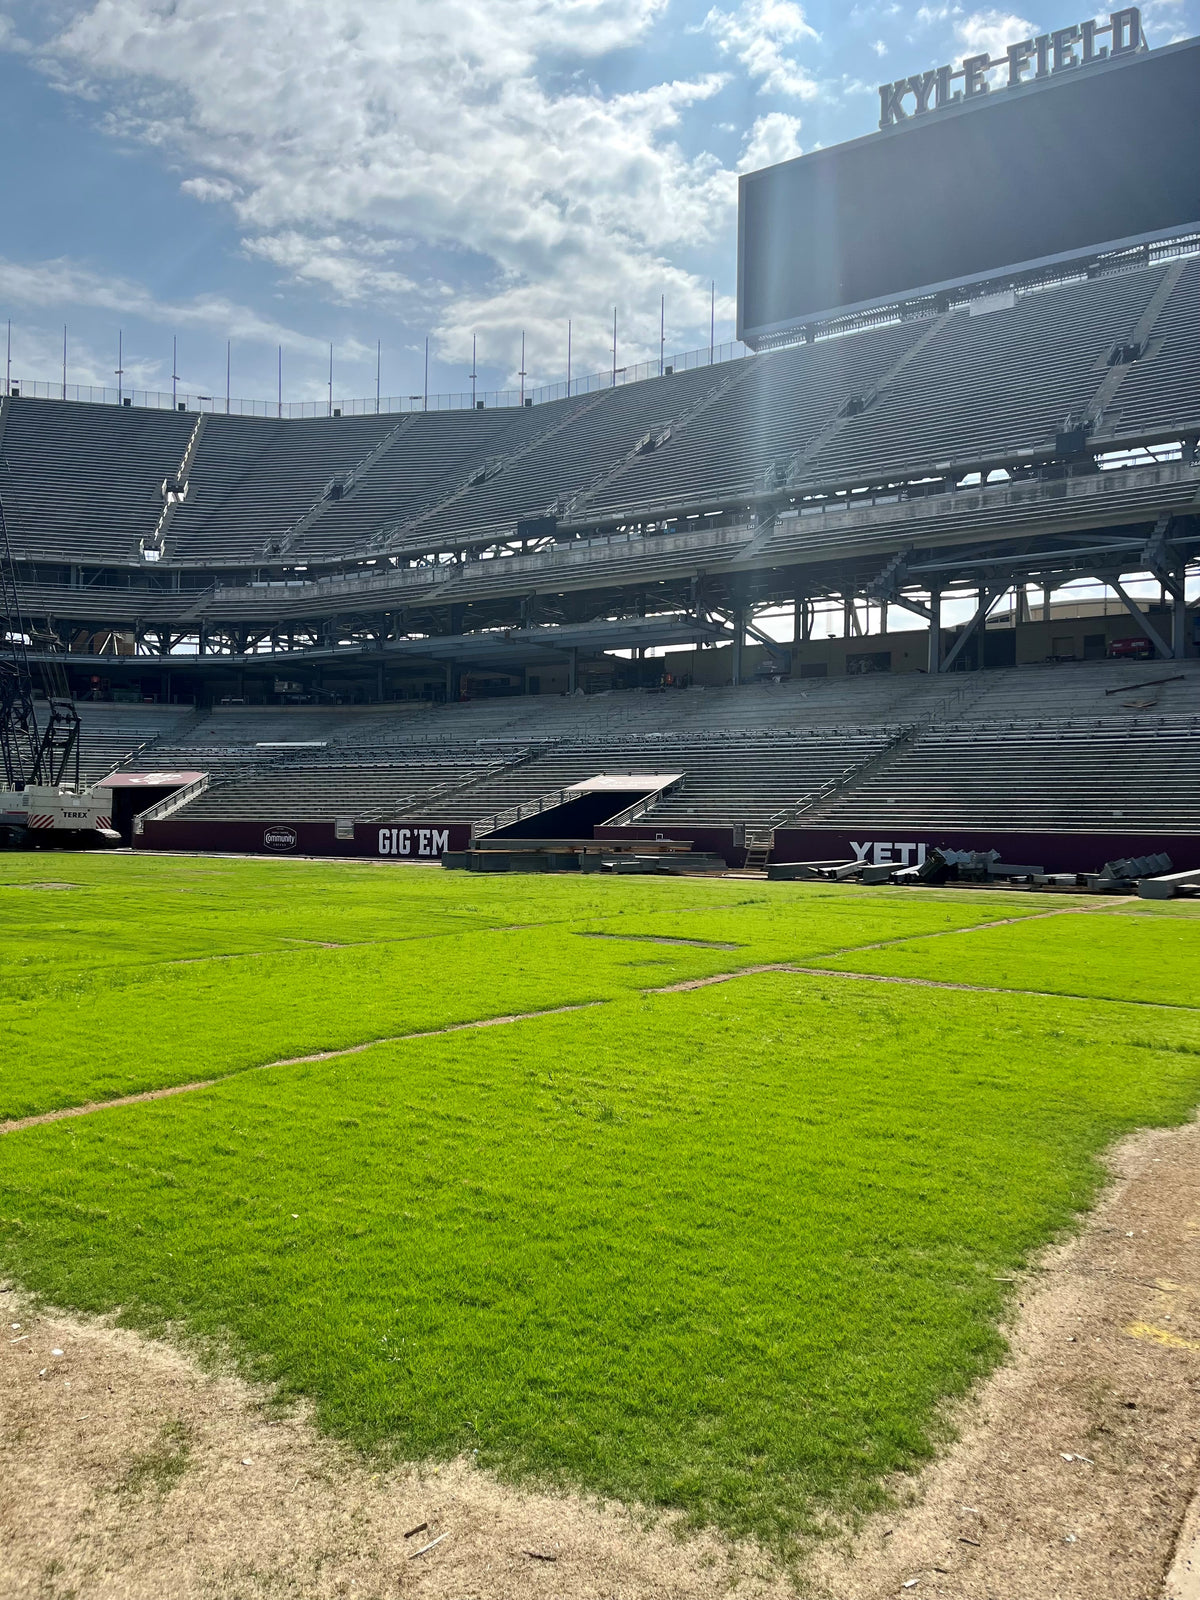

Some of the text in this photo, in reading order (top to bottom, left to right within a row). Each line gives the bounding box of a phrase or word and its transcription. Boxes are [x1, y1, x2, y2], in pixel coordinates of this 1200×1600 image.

[878, 7, 1142, 129] KYLE FIELD
[63, 811, 88, 819] TEREX
[265, 833, 295, 845] Community
[849, 841, 926, 867] YETI
